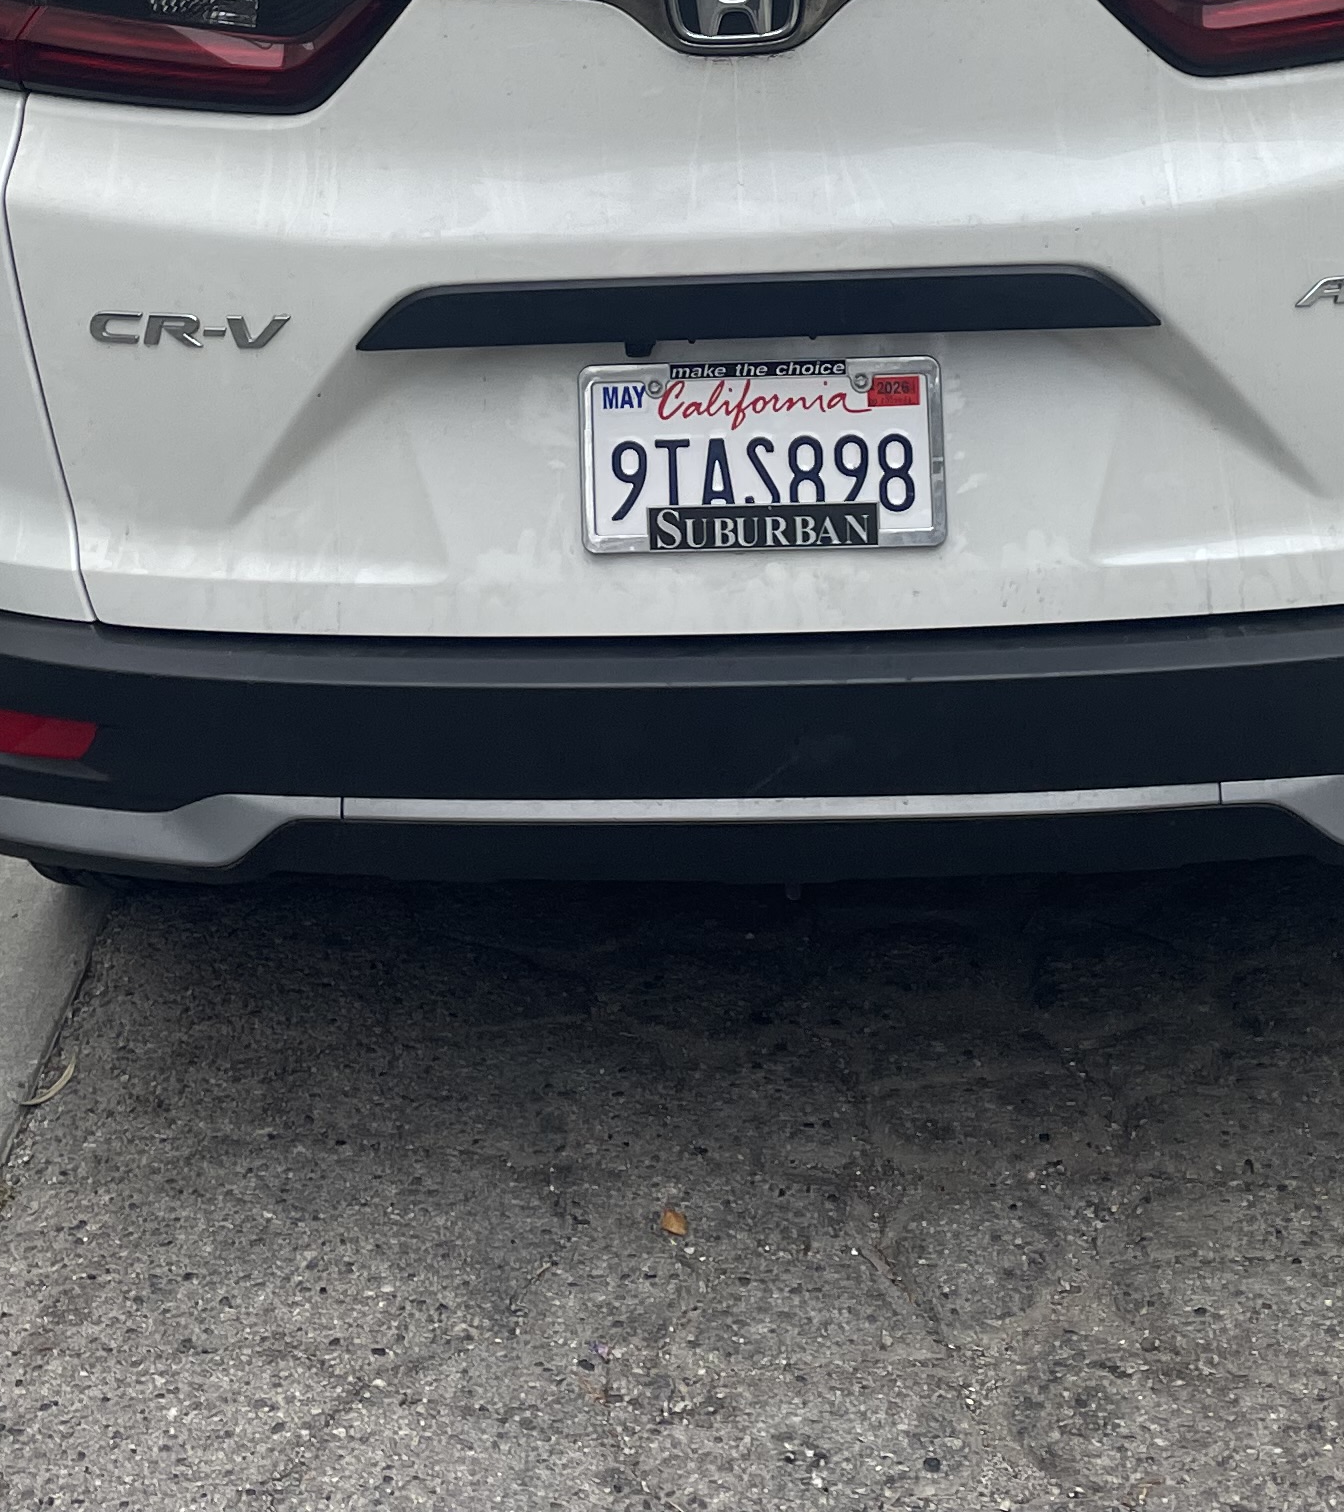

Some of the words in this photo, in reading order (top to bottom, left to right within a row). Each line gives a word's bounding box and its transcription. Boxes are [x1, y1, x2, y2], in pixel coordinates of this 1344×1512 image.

[89, 310, 291, 348] CR-V
[671, 364, 727, 378] make
[735, 363, 768, 377] the
[775, 360, 845, 376] choice
[602, 386, 646, 409] MAY
[658, 379, 872, 431] California
[611, 433, 916, 521] 9TAS898
[656, 508, 870, 549] SUBURBAN
